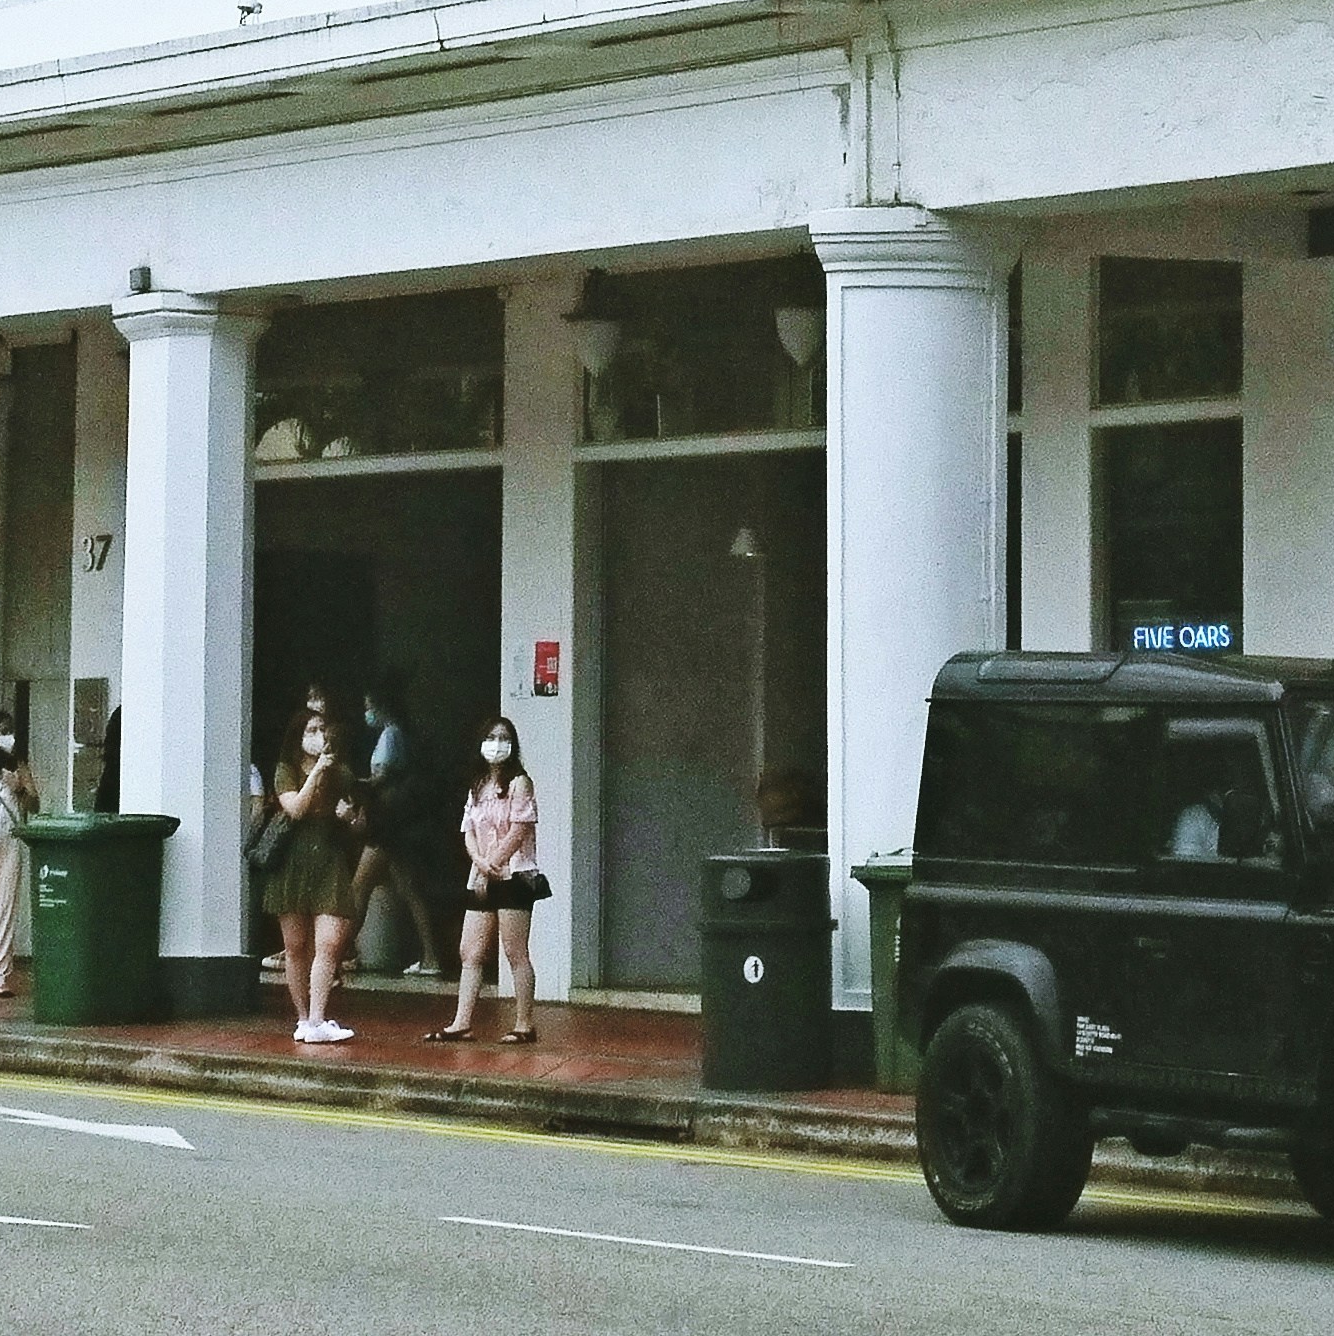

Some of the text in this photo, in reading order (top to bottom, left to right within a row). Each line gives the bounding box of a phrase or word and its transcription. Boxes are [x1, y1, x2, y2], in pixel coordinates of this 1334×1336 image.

[82, 534, 113, 572] 37
[1133, 624, 1230, 649] FIVE OARS
